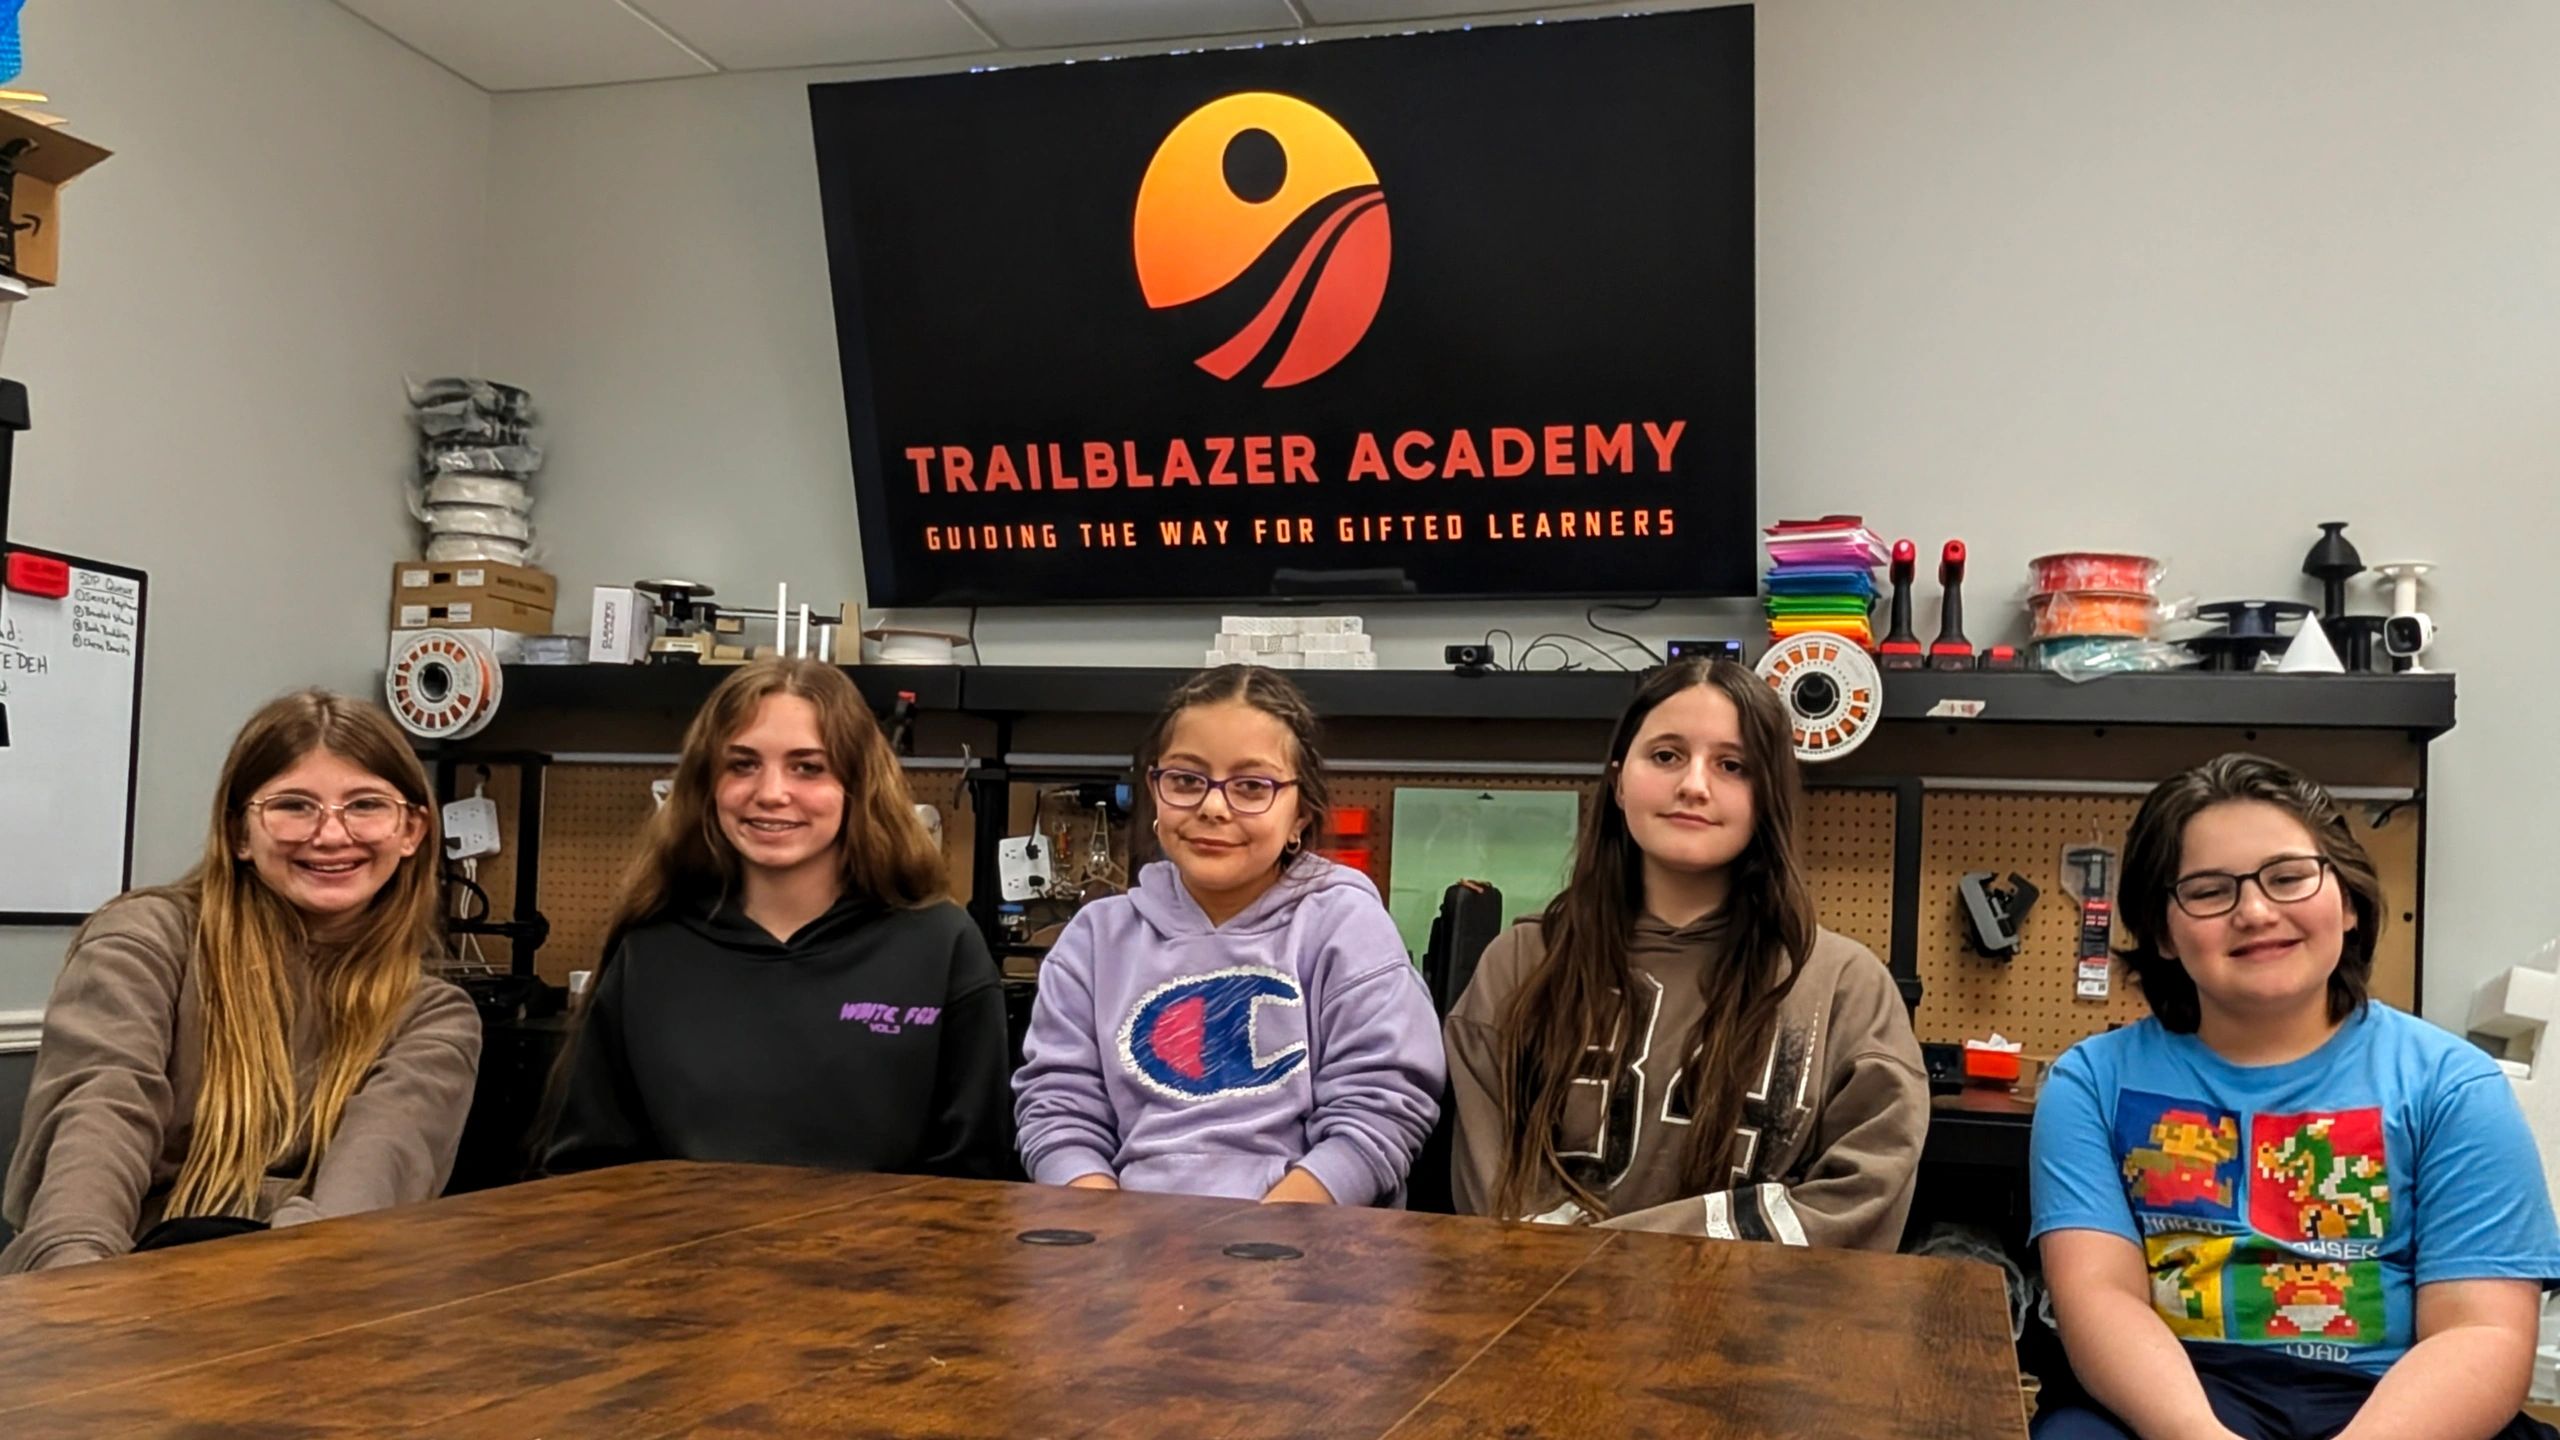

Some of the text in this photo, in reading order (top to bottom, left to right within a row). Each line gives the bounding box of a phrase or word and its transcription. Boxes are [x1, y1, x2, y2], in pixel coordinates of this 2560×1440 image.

[906, 420, 1686, 493] TRAILBLAZER ACADEMY
[926, 508, 1674, 551] GUIDING THE WAY FOR GIFTED LEARNERS
[16, 652, 48, 674] DEH
[2292, 1240, 2379, 1260] OWSER
